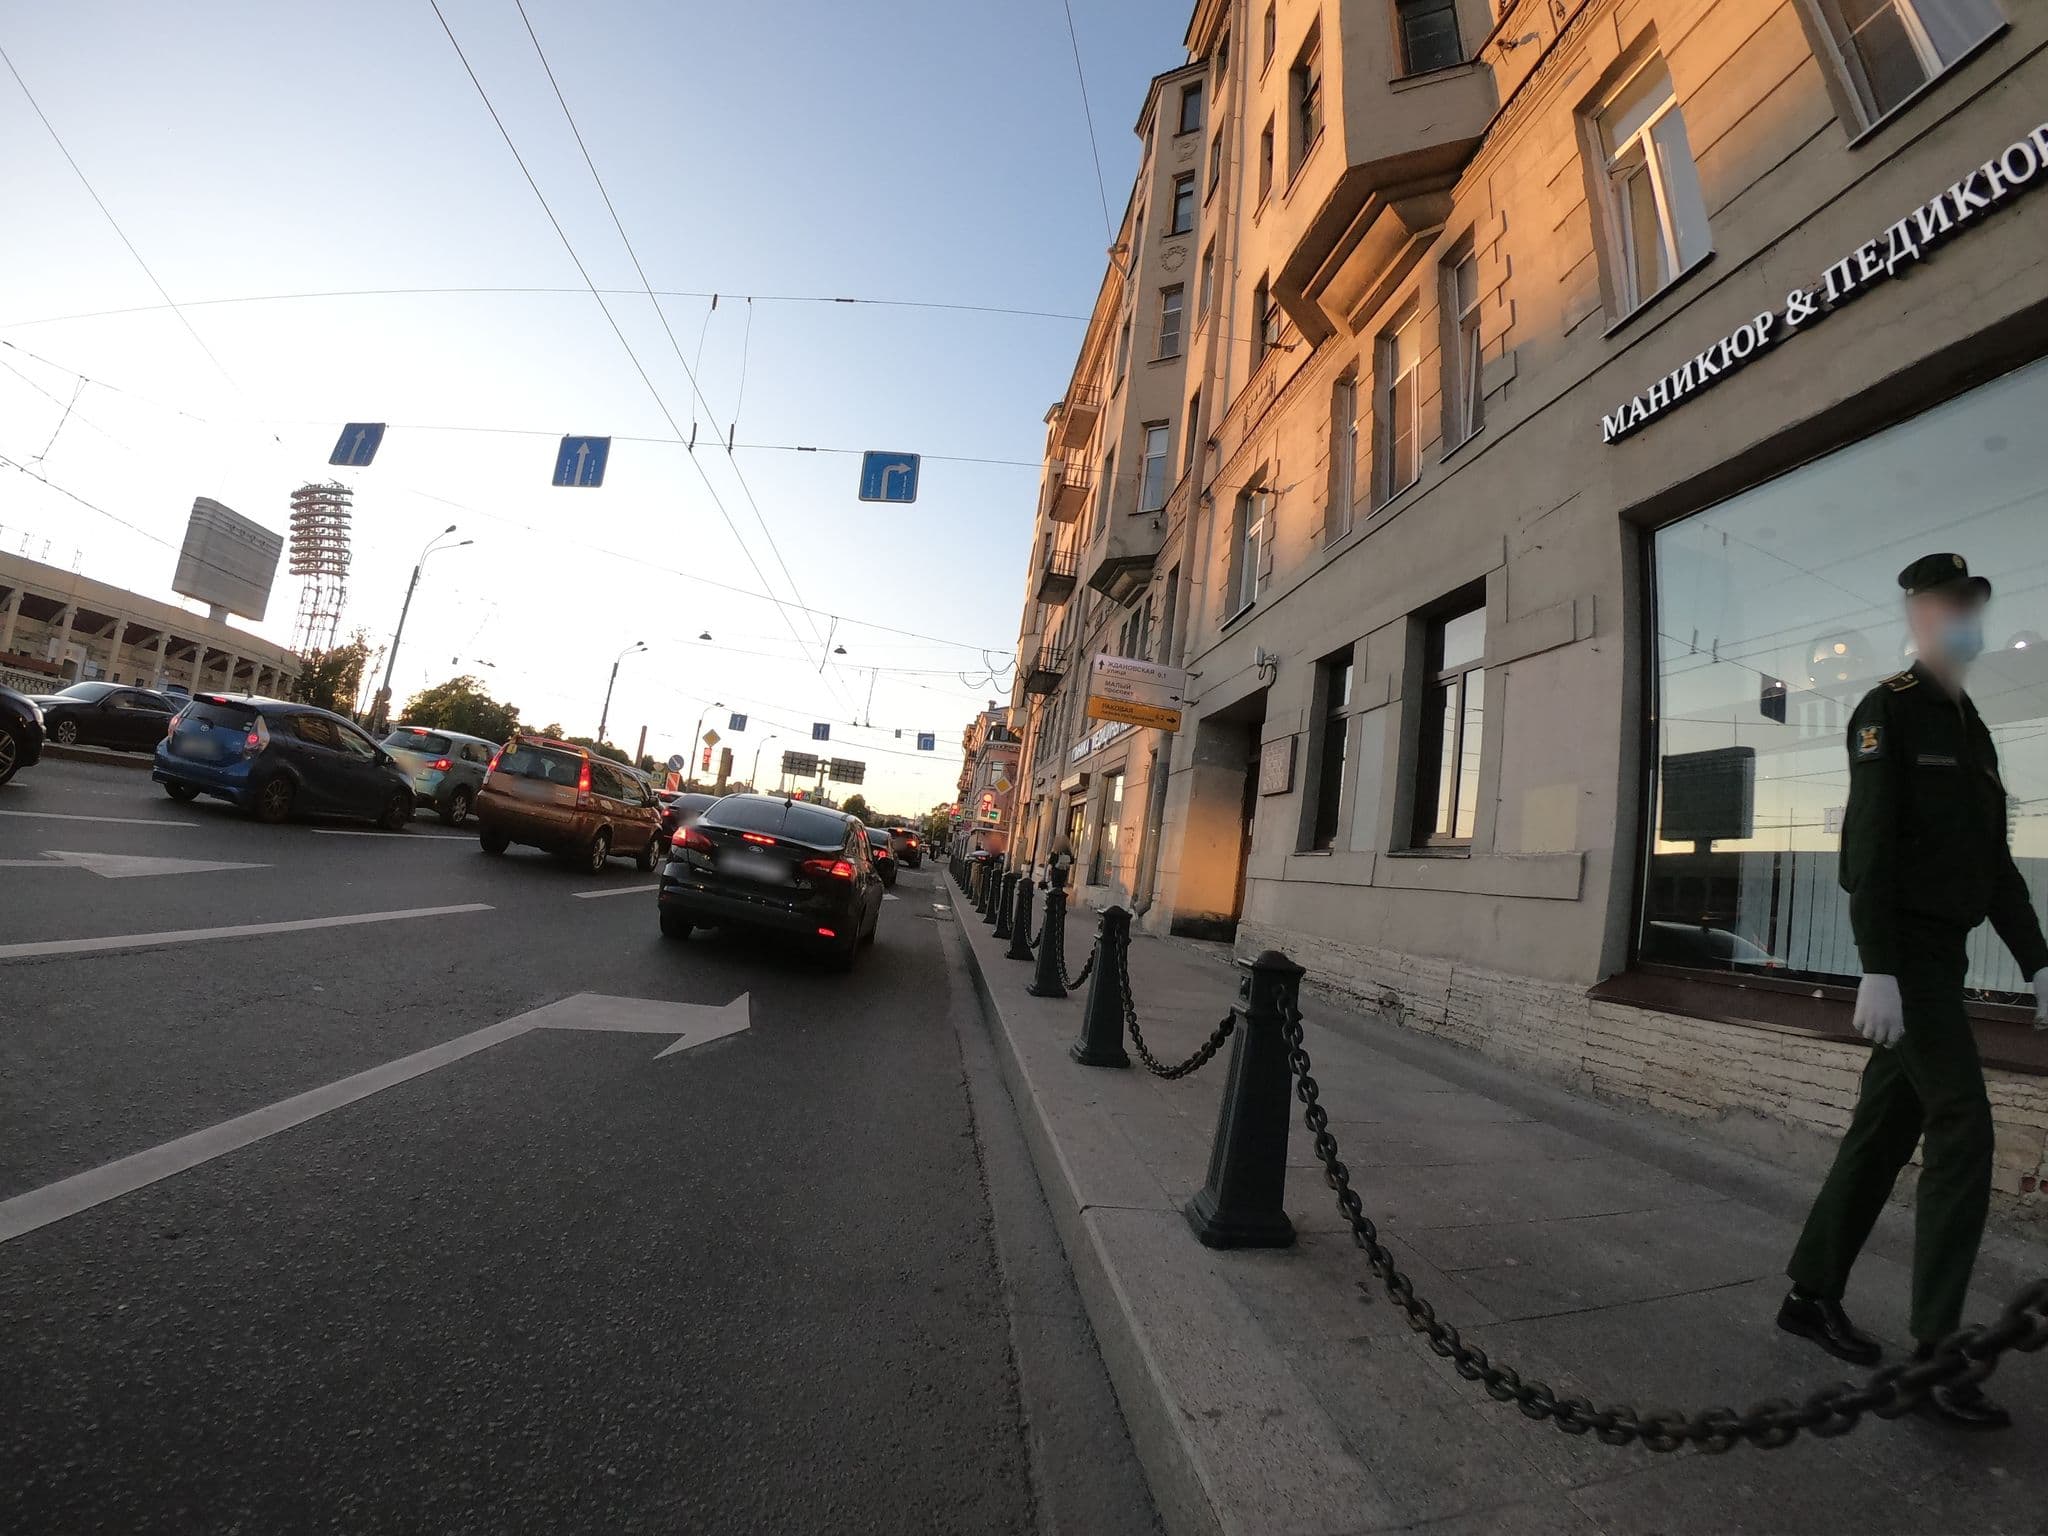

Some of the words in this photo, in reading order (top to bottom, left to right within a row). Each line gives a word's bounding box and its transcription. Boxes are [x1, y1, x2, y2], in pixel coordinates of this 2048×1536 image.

[1601, 311, 1774, 442] МАНИКЮР
[1785, 289, 1817, 328] &
[1107, 661, 1155, 674] ЖДАНОВСКАЯ
